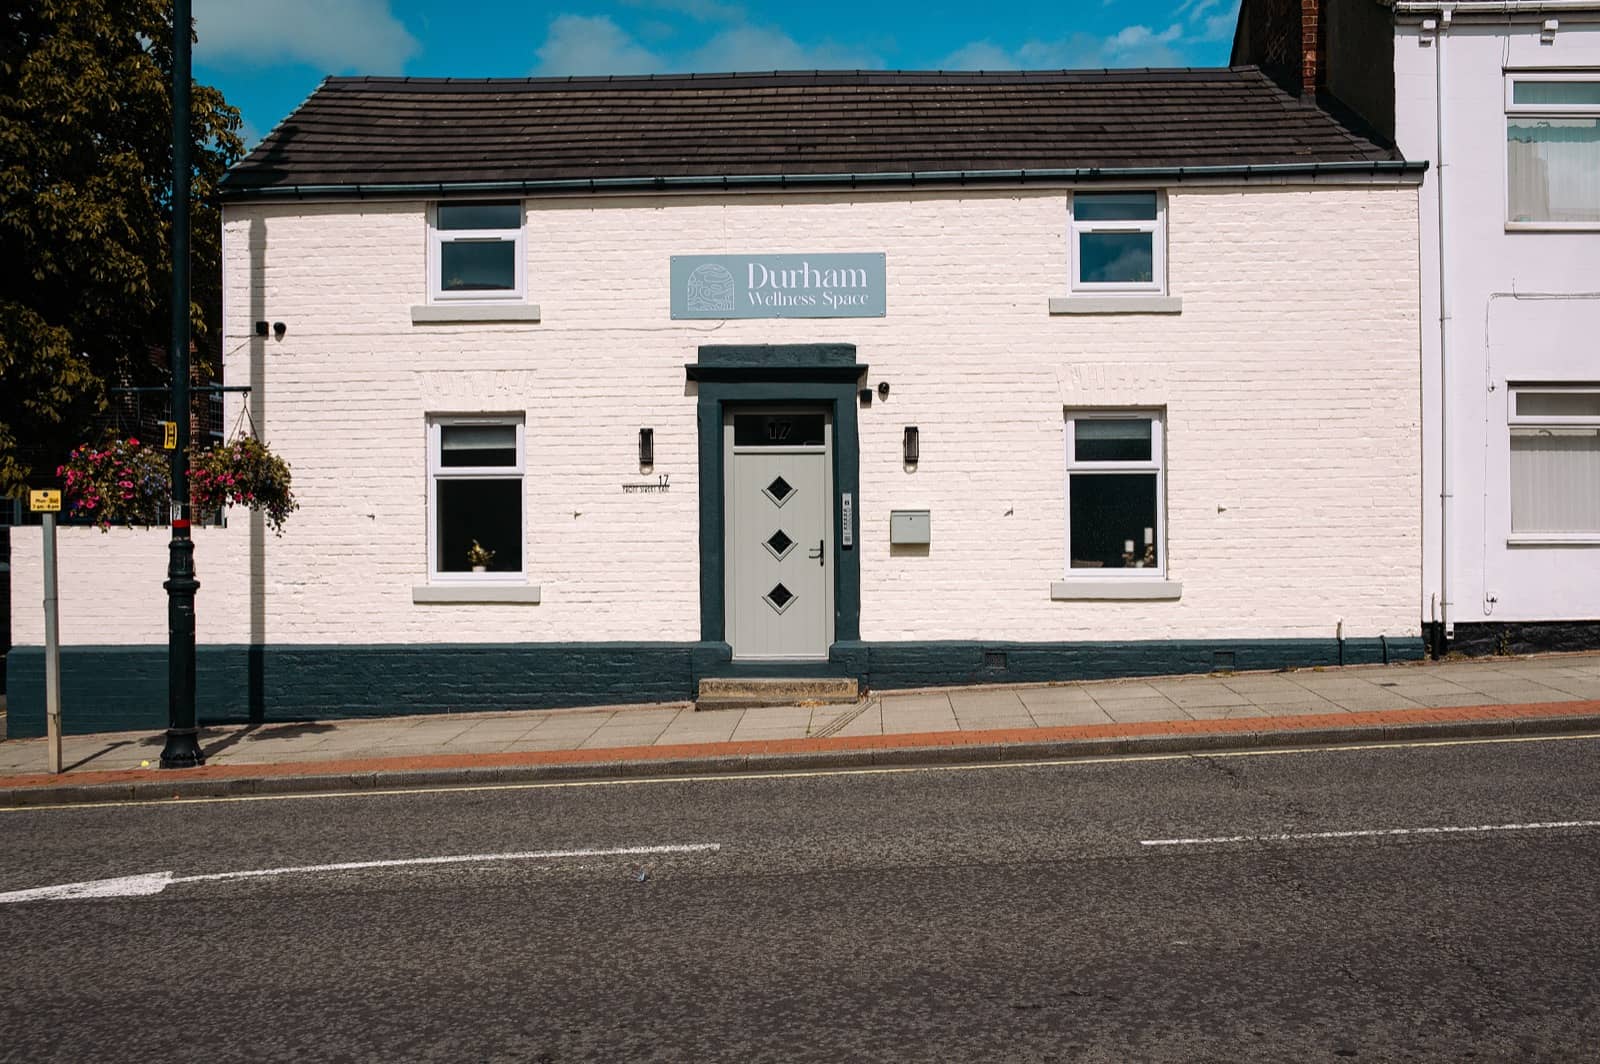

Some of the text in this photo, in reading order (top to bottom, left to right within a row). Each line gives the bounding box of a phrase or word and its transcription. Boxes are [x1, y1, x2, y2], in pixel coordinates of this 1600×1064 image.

[748, 262, 867, 289] Durham
[748, 291, 869, 309] Wellness Space
[769, 422, 792, 440] 17
[659, 474, 669, 486] 17
